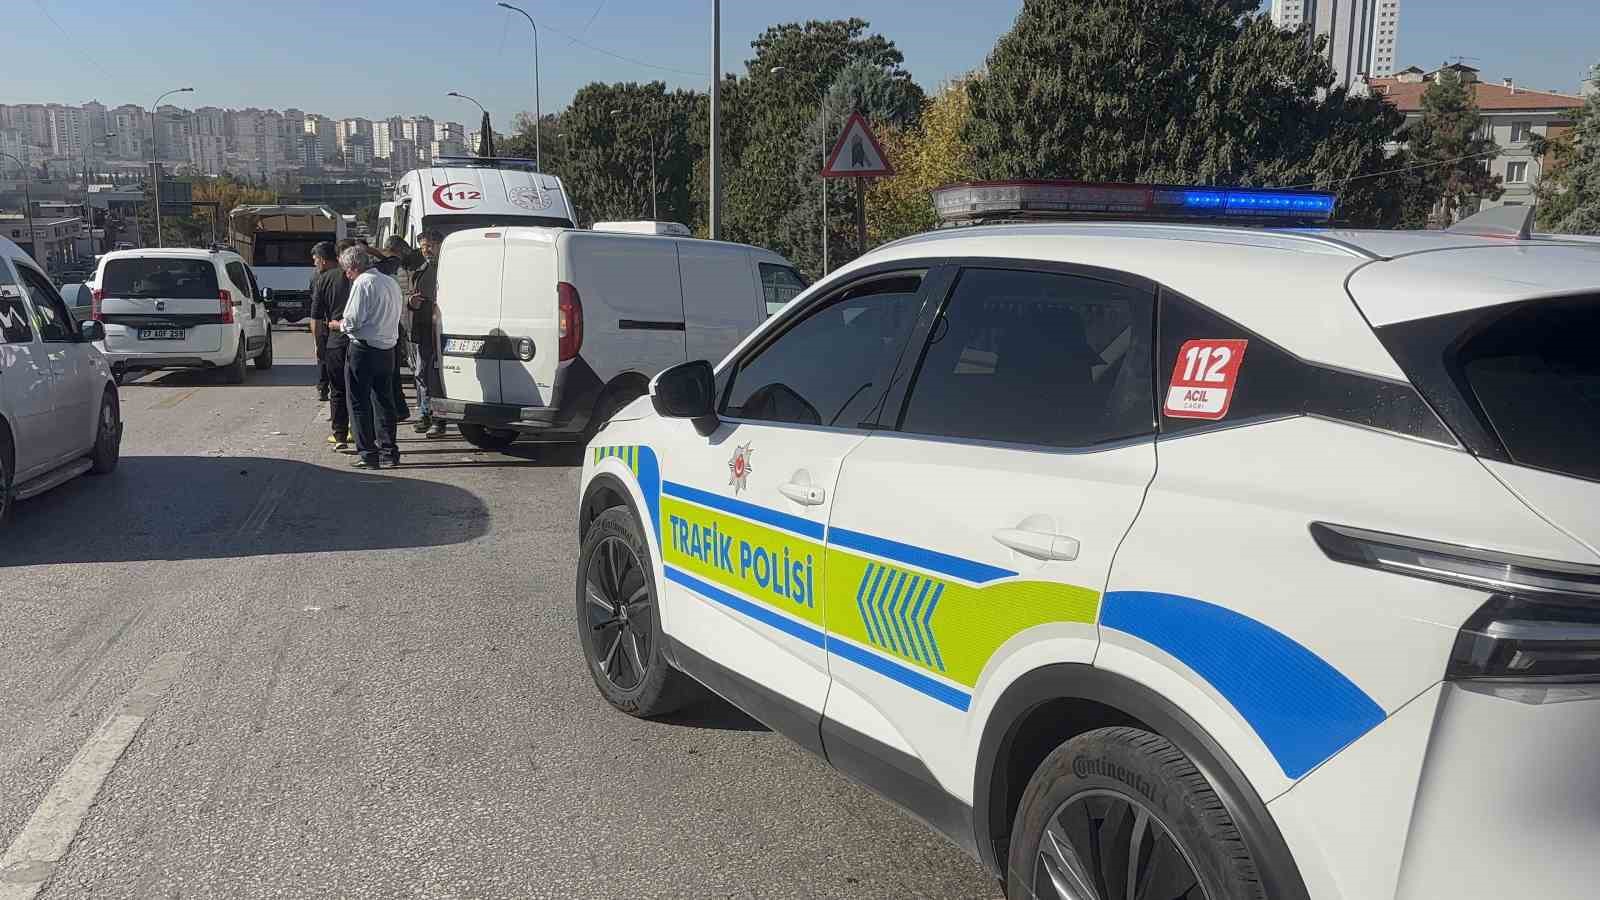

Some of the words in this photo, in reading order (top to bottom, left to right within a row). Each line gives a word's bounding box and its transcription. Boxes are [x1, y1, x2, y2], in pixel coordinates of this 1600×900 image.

[443, 191, 481, 201] 112
[1183, 346, 1232, 382] 112
[669, 513, 734, 574] TRAFİK
[739, 540, 814, 608] POLİSİ
[1072, 754, 1157, 800] Continental
